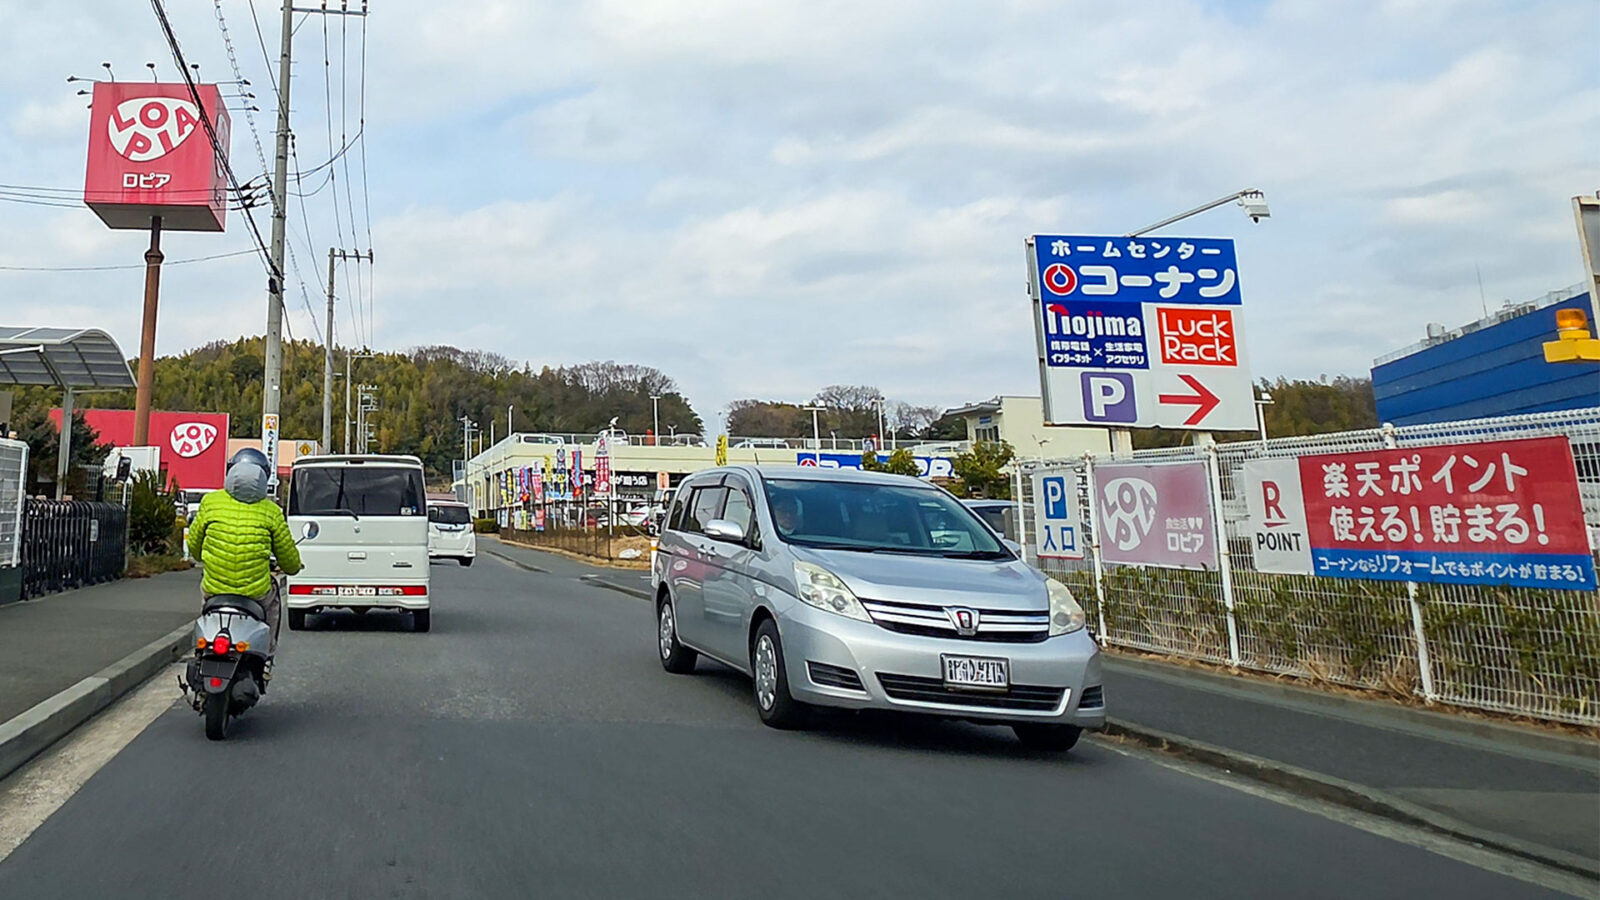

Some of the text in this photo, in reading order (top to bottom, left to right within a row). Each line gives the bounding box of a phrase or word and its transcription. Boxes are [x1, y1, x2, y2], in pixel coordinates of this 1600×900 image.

[122, 172, 171, 189] ロピア
[1051, 239, 1221, 260] ホームセンター
[1078, 265, 1236, 298] コーナン
[1160, 312, 1230, 338] Luck
[1163, 336, 1233, 362] Rack
[1089, 376, 1126, 417] P
[1321, 452, 1528, 498] 楽天ポイント
[1046, 481, 1062, 516] P
[1043, 524, 1076, 552] 入口
[1166, 532, 1204, 553] ロピア
[1256, 532, 1301, 551] POINT
